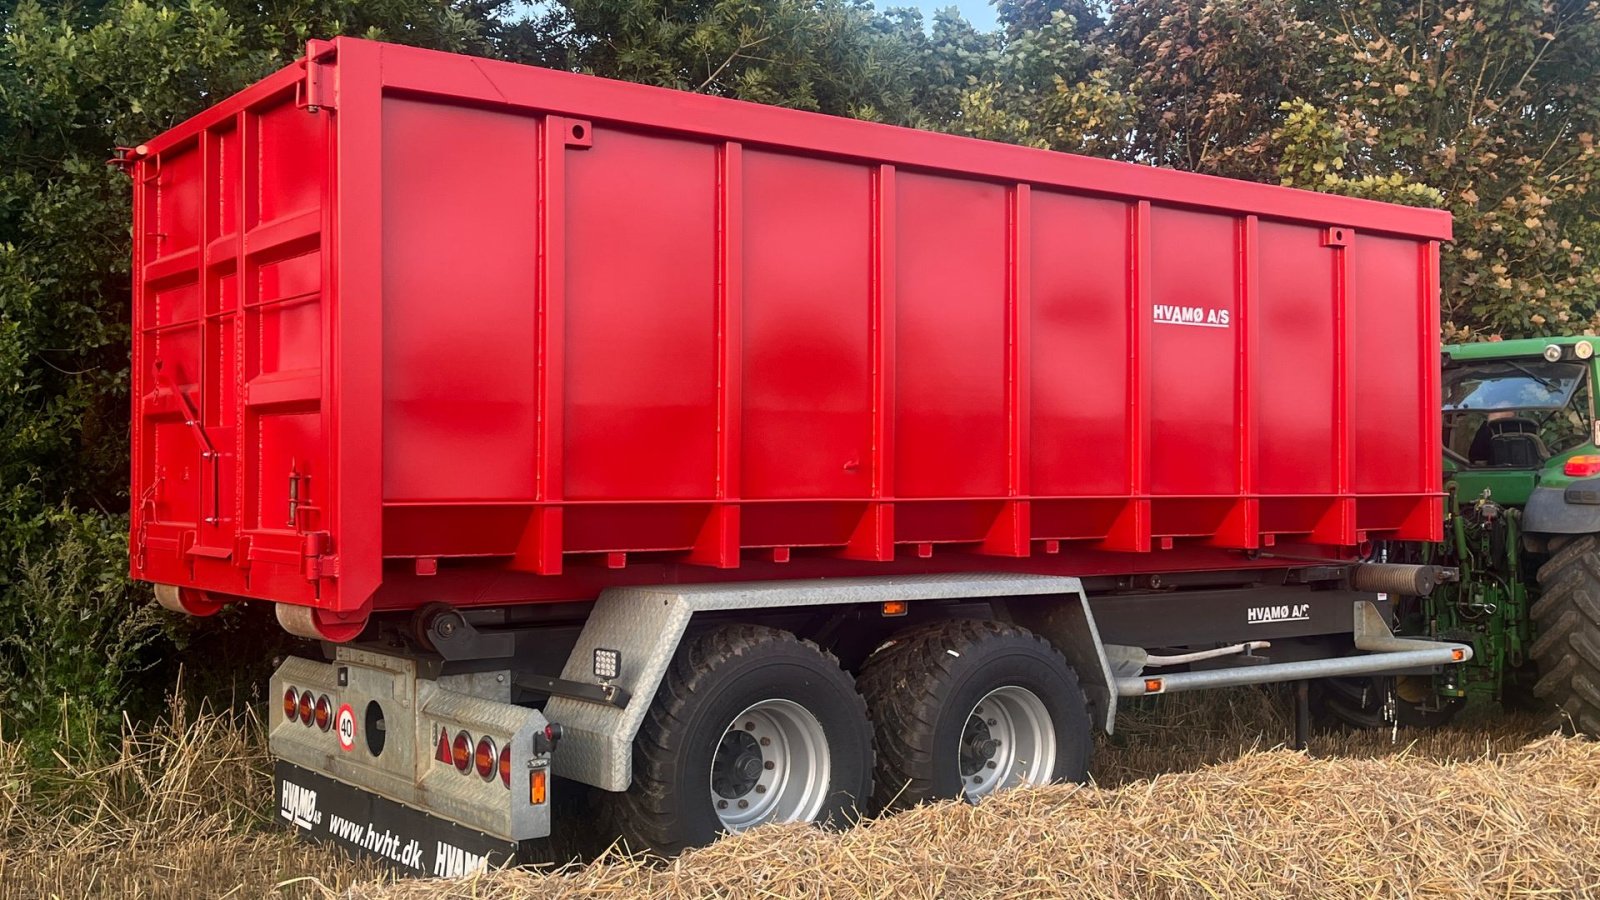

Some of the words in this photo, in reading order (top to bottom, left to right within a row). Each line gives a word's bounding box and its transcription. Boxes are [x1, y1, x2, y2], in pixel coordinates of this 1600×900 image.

[1153, 304, 1204, 323] HVAMØ
[1207, 309, 1230, 325] A/S
[1247, 605, 1289, 621] HVAMØ
[341, 718, 352, 738] 40
[329, 813, 424, 870] www.hvht.dk
